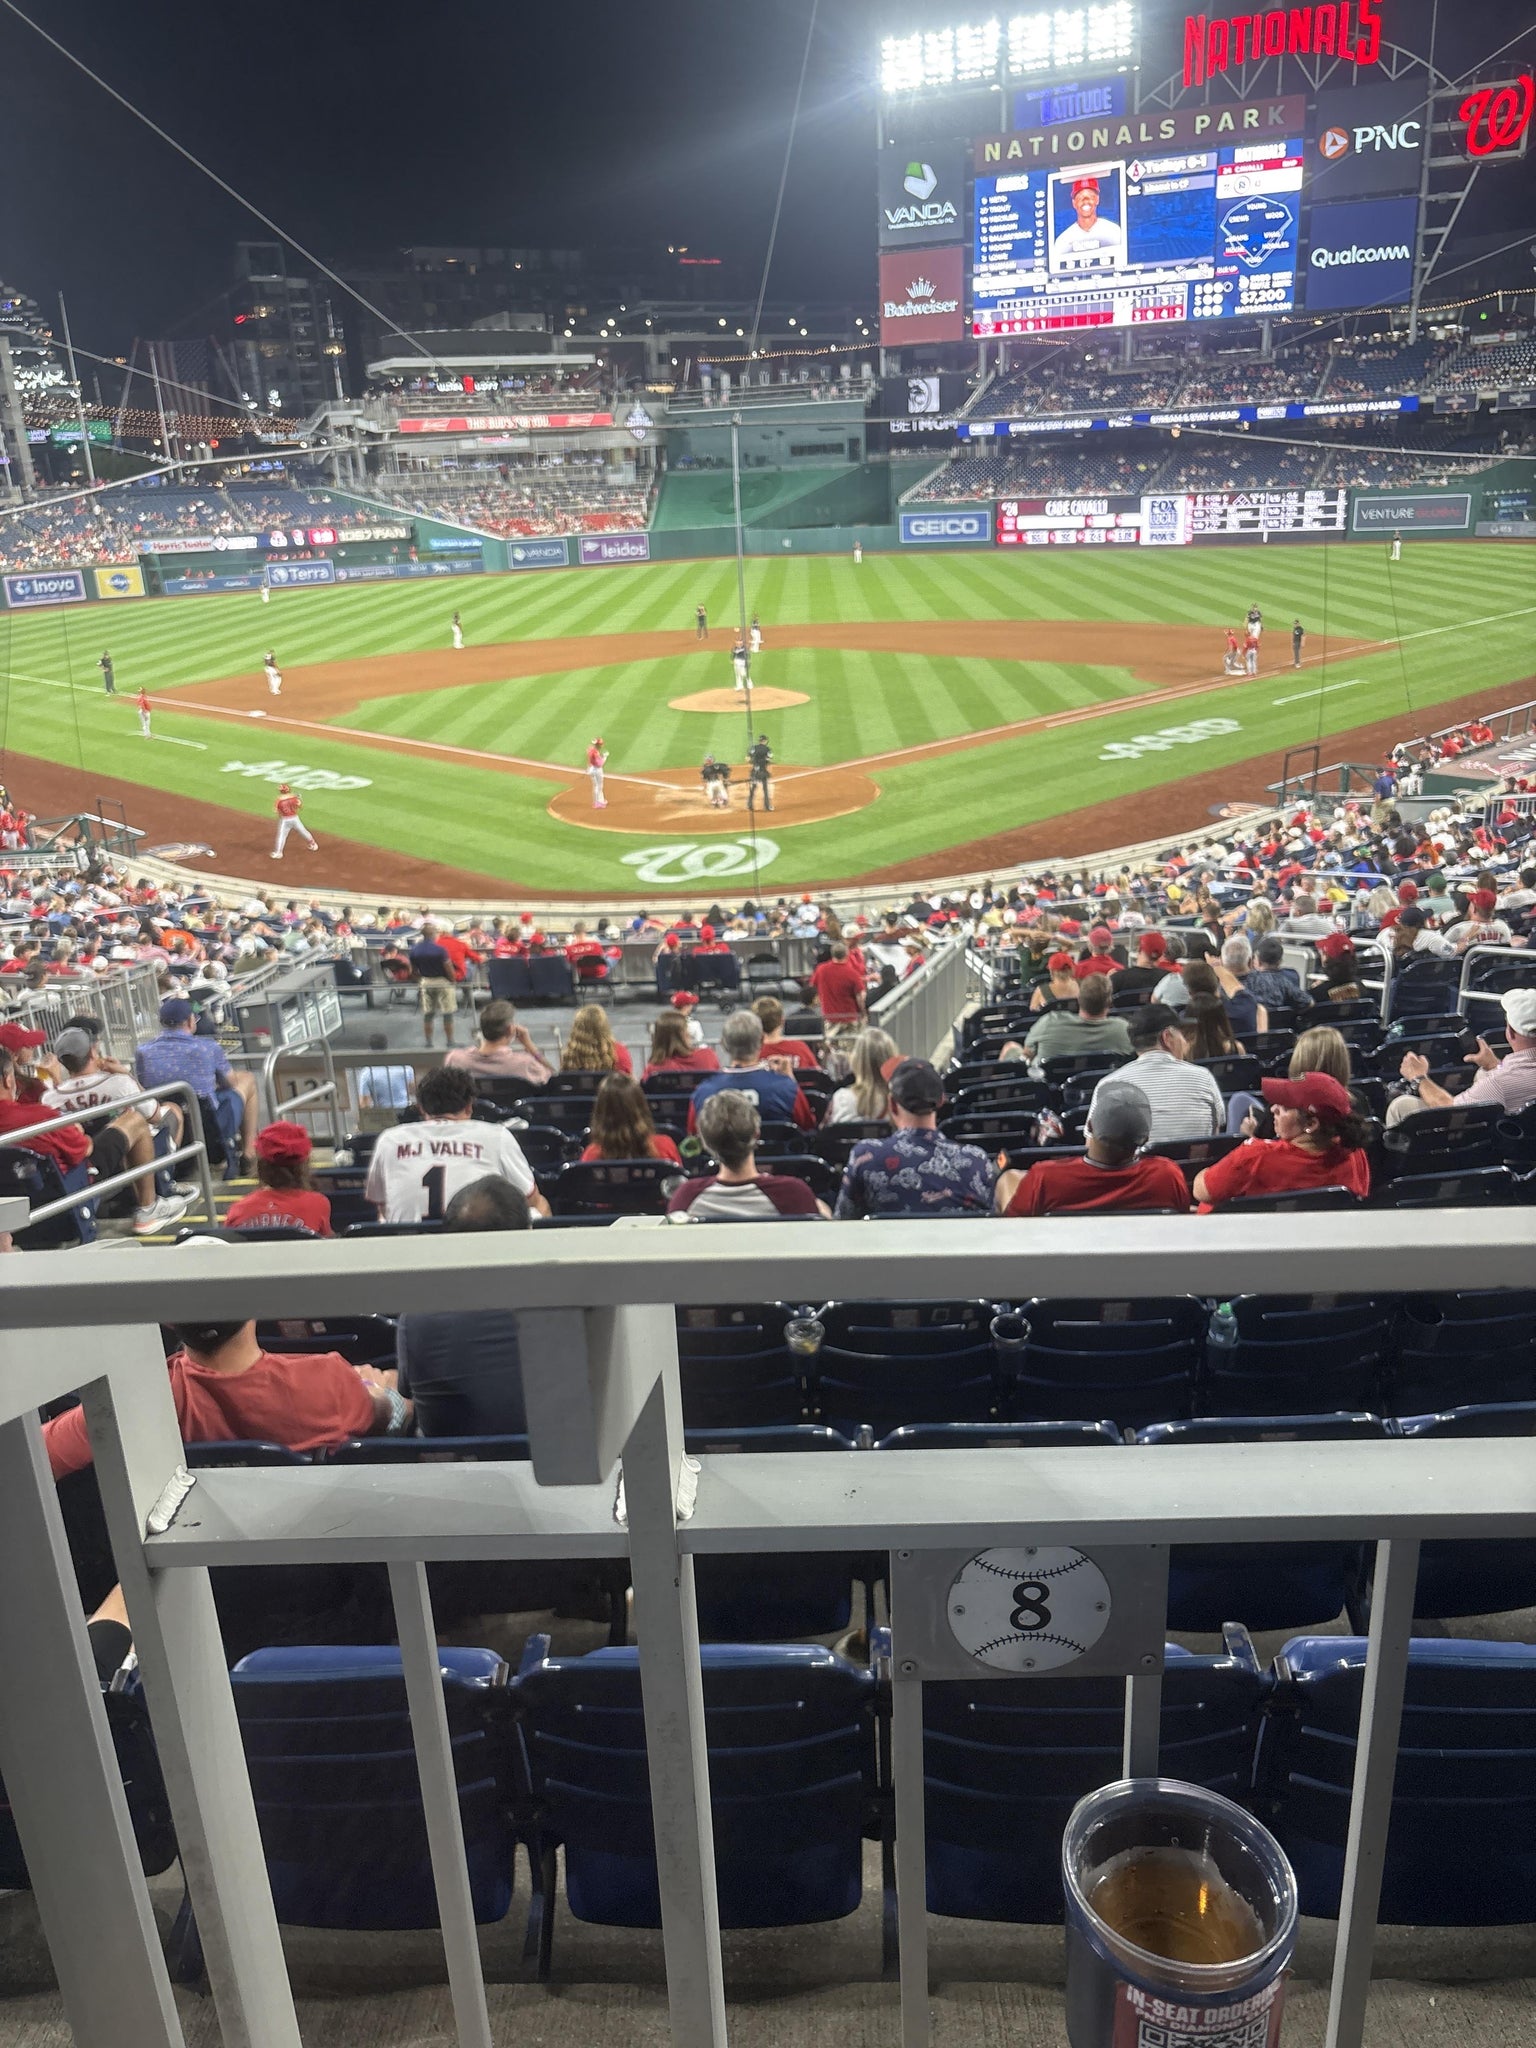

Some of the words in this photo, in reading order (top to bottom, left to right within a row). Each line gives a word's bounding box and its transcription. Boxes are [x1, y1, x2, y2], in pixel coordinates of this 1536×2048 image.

[1183, 0, 1380, 88] NATIONALS
[985, 119, 1175, 162] NATIONALS
[1195, 105, 1285, 135] PARK
[1353, 121, 1420, 153] PNC
[885, 201, 957, 224] VANDA
[1311, 245, 1410, 268] Qualcomm
[1240, 289, 1286, 305] $7,200
[884, 299, 958, 318] Budweiser
[1045, 500, 1070, 516] CADE
[1071, 499, 1108, 515] CAVALLI
[1151, 500, 1177, 512] FOX
[1361, 508, 1415, 520] VENTURE
[910, 518, 979, 535] GEICO
[601, 542, 647, 558] leidos
[289, 567, 330, 580] Terra
[33, 577, 75, 594] Inova
[397, 1142, 423, 1160] MJ
[430, 1140, 485, 1159] VALET
[422, 1163, 446, 1218] 1
[1010, 1581, 1052, 1631] 8
[1126, 1984, 1200, 2024] IN-SEAT
[1169, 2015, 1243, 2033] DIAMOND
